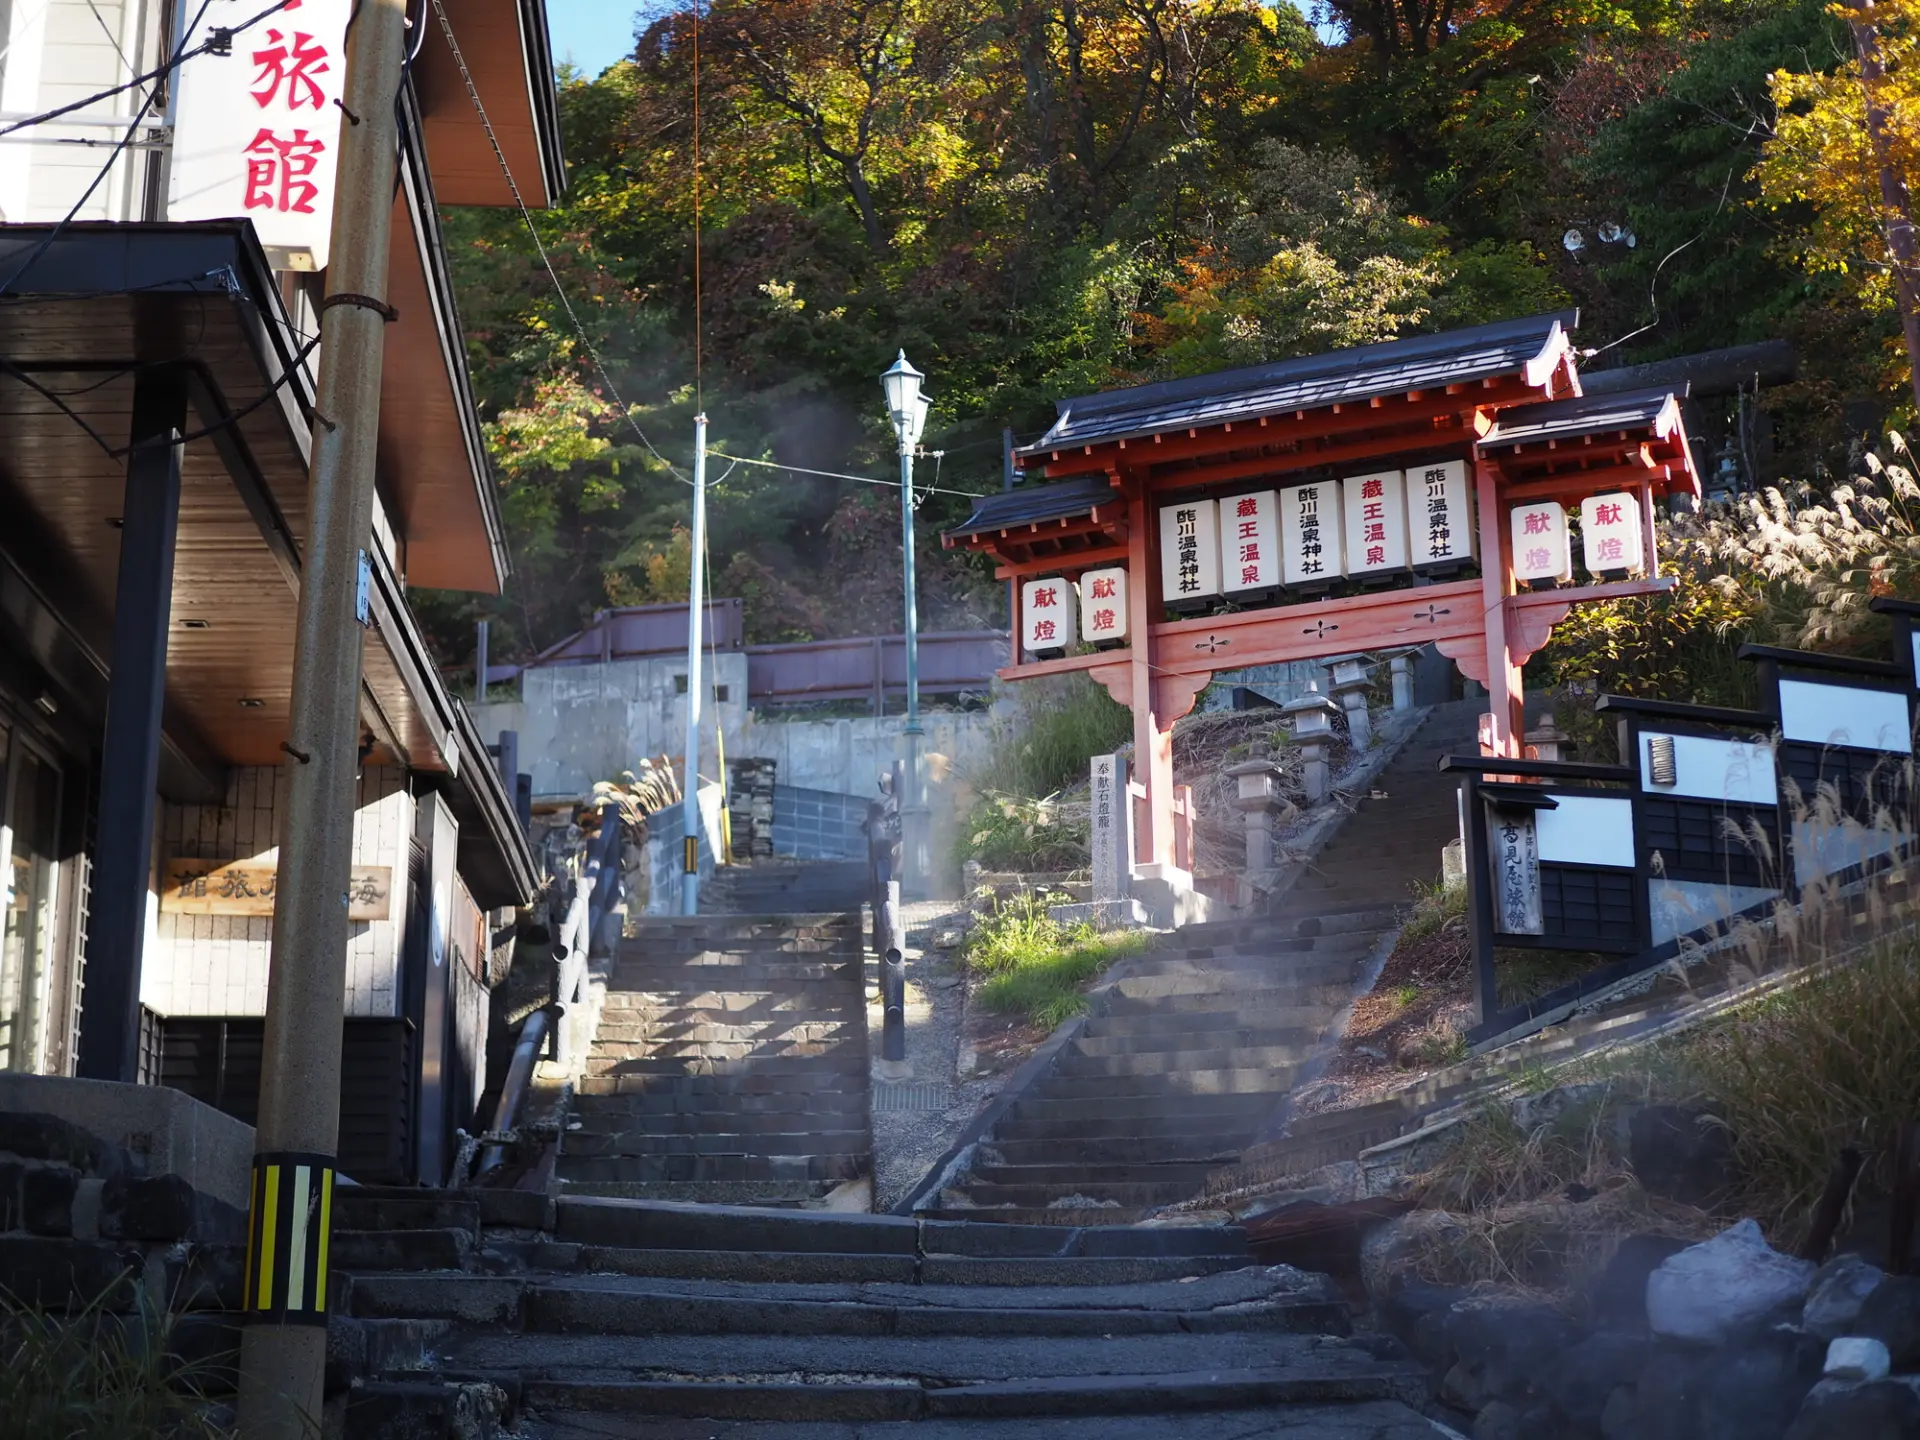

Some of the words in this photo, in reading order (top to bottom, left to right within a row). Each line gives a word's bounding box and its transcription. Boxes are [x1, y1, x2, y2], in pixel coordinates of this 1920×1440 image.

[242, 0, 330, 214] 旅館
[1176, 508, 1200, 593] 酢川温泉神社
[1237, 498, 1261, 585] 蔵王温泉
[1298, 487, 1324, 575] 酢川温泉神社
[1361, 479, 1386, 566] 蔵王温泉
[1424, 468, 1453, 558] 酢川温泉神社
[1522, 511, 1552, 571] 献燈
[1594, 503, 1623, 561] 献燈
[1033, 587, 1057, 641] 献燈
[1091, 577, 1116, 631] 献燈
